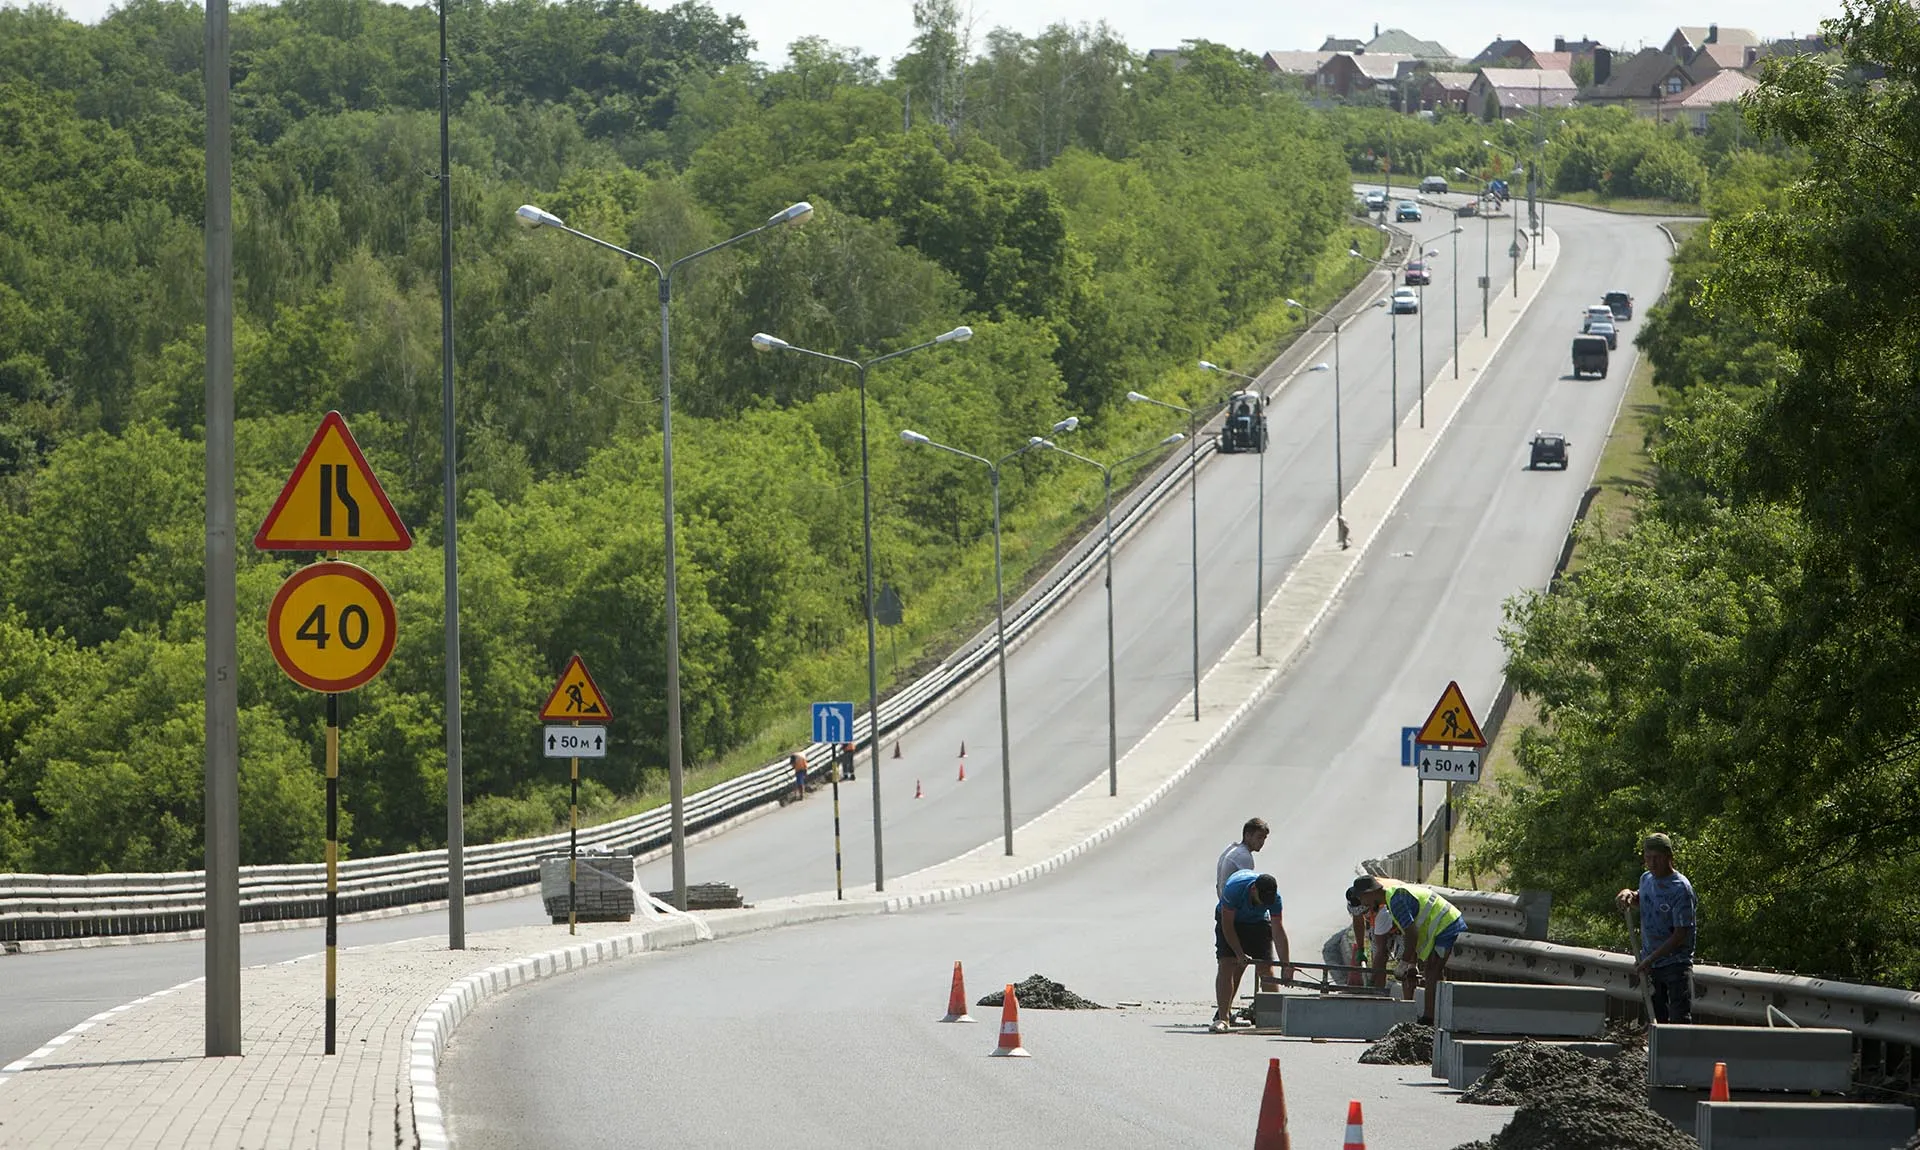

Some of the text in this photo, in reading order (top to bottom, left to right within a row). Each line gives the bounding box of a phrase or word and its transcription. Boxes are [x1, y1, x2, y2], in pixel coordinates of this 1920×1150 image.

[296, 604, 369, 650] 40
[561, 736, 578, 748] 50
[1435, 760, 1452, 771] 50
